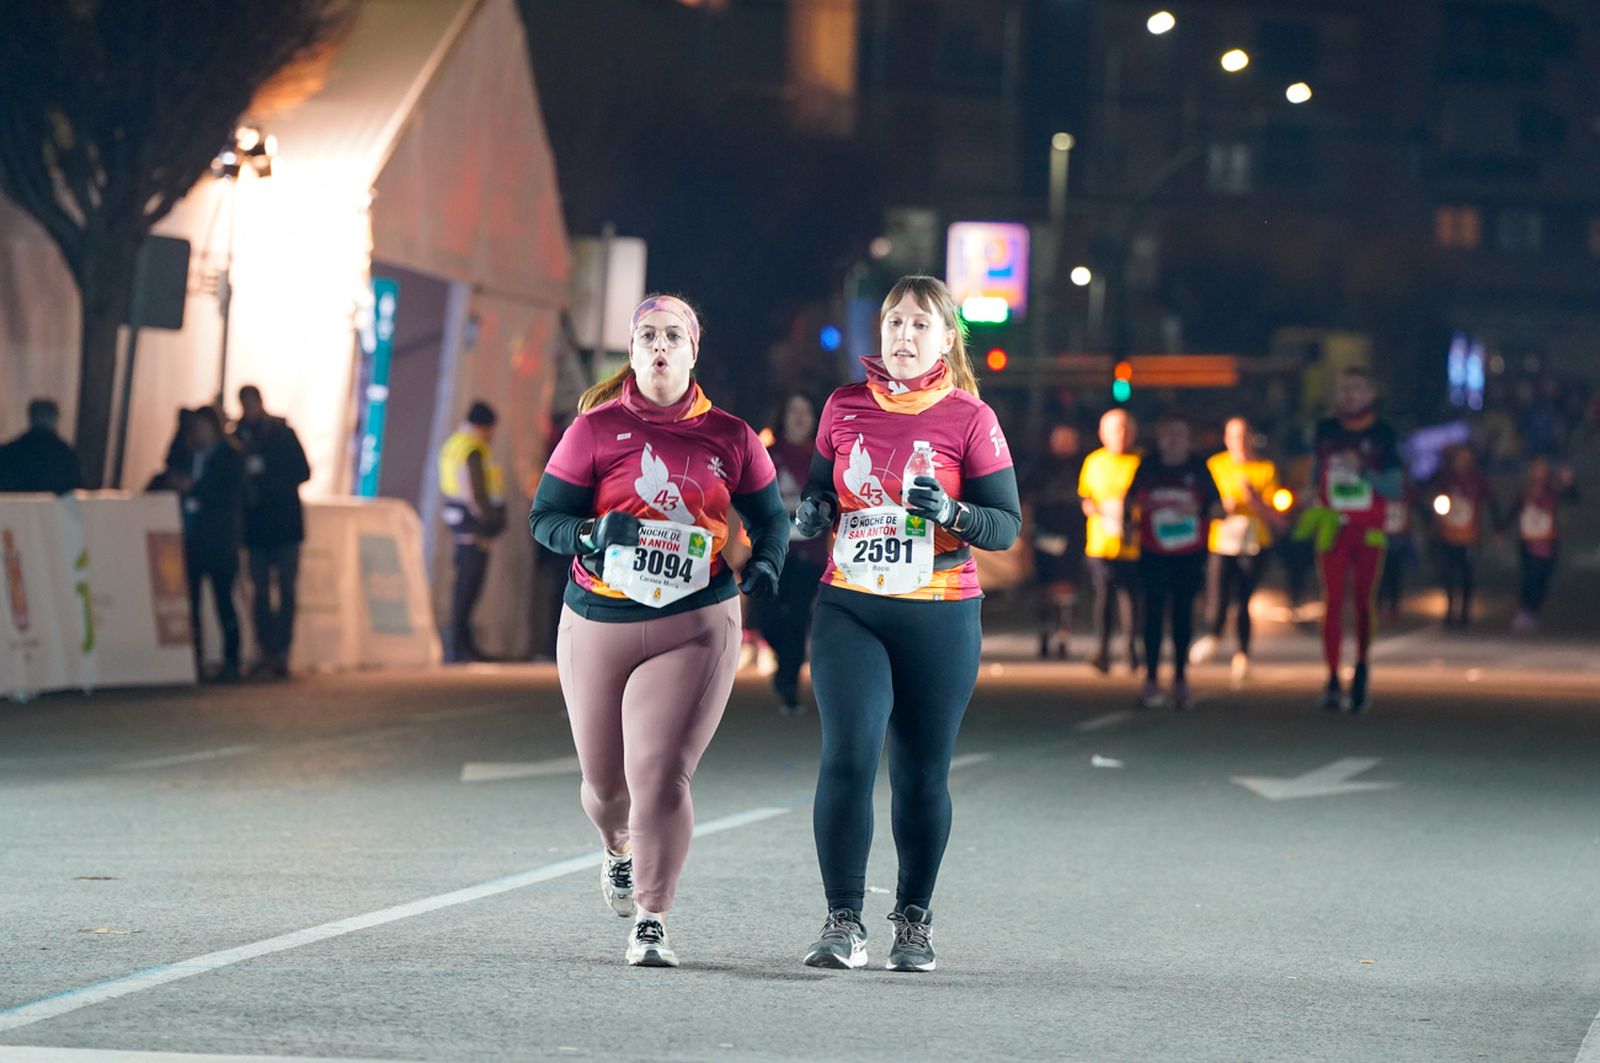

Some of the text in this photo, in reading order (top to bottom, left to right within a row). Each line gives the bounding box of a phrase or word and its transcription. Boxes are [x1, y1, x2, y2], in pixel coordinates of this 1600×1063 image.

[653, 489, 679, 512] 43
[860, 482, 883, 506] 43
[859, 515, 898, 527] NOCHE DE
[640, 527, 669, 539] NOCHE
[670, 532, 681, 542] DE
[848, 530, 866, 540] SAN
[867, 524, 897, 538] ANTÓN
[648, 538, 680, 552] ANTÓN
[853, 537, 913, 563] 2591
[633, 547, 694, 584] 3094
